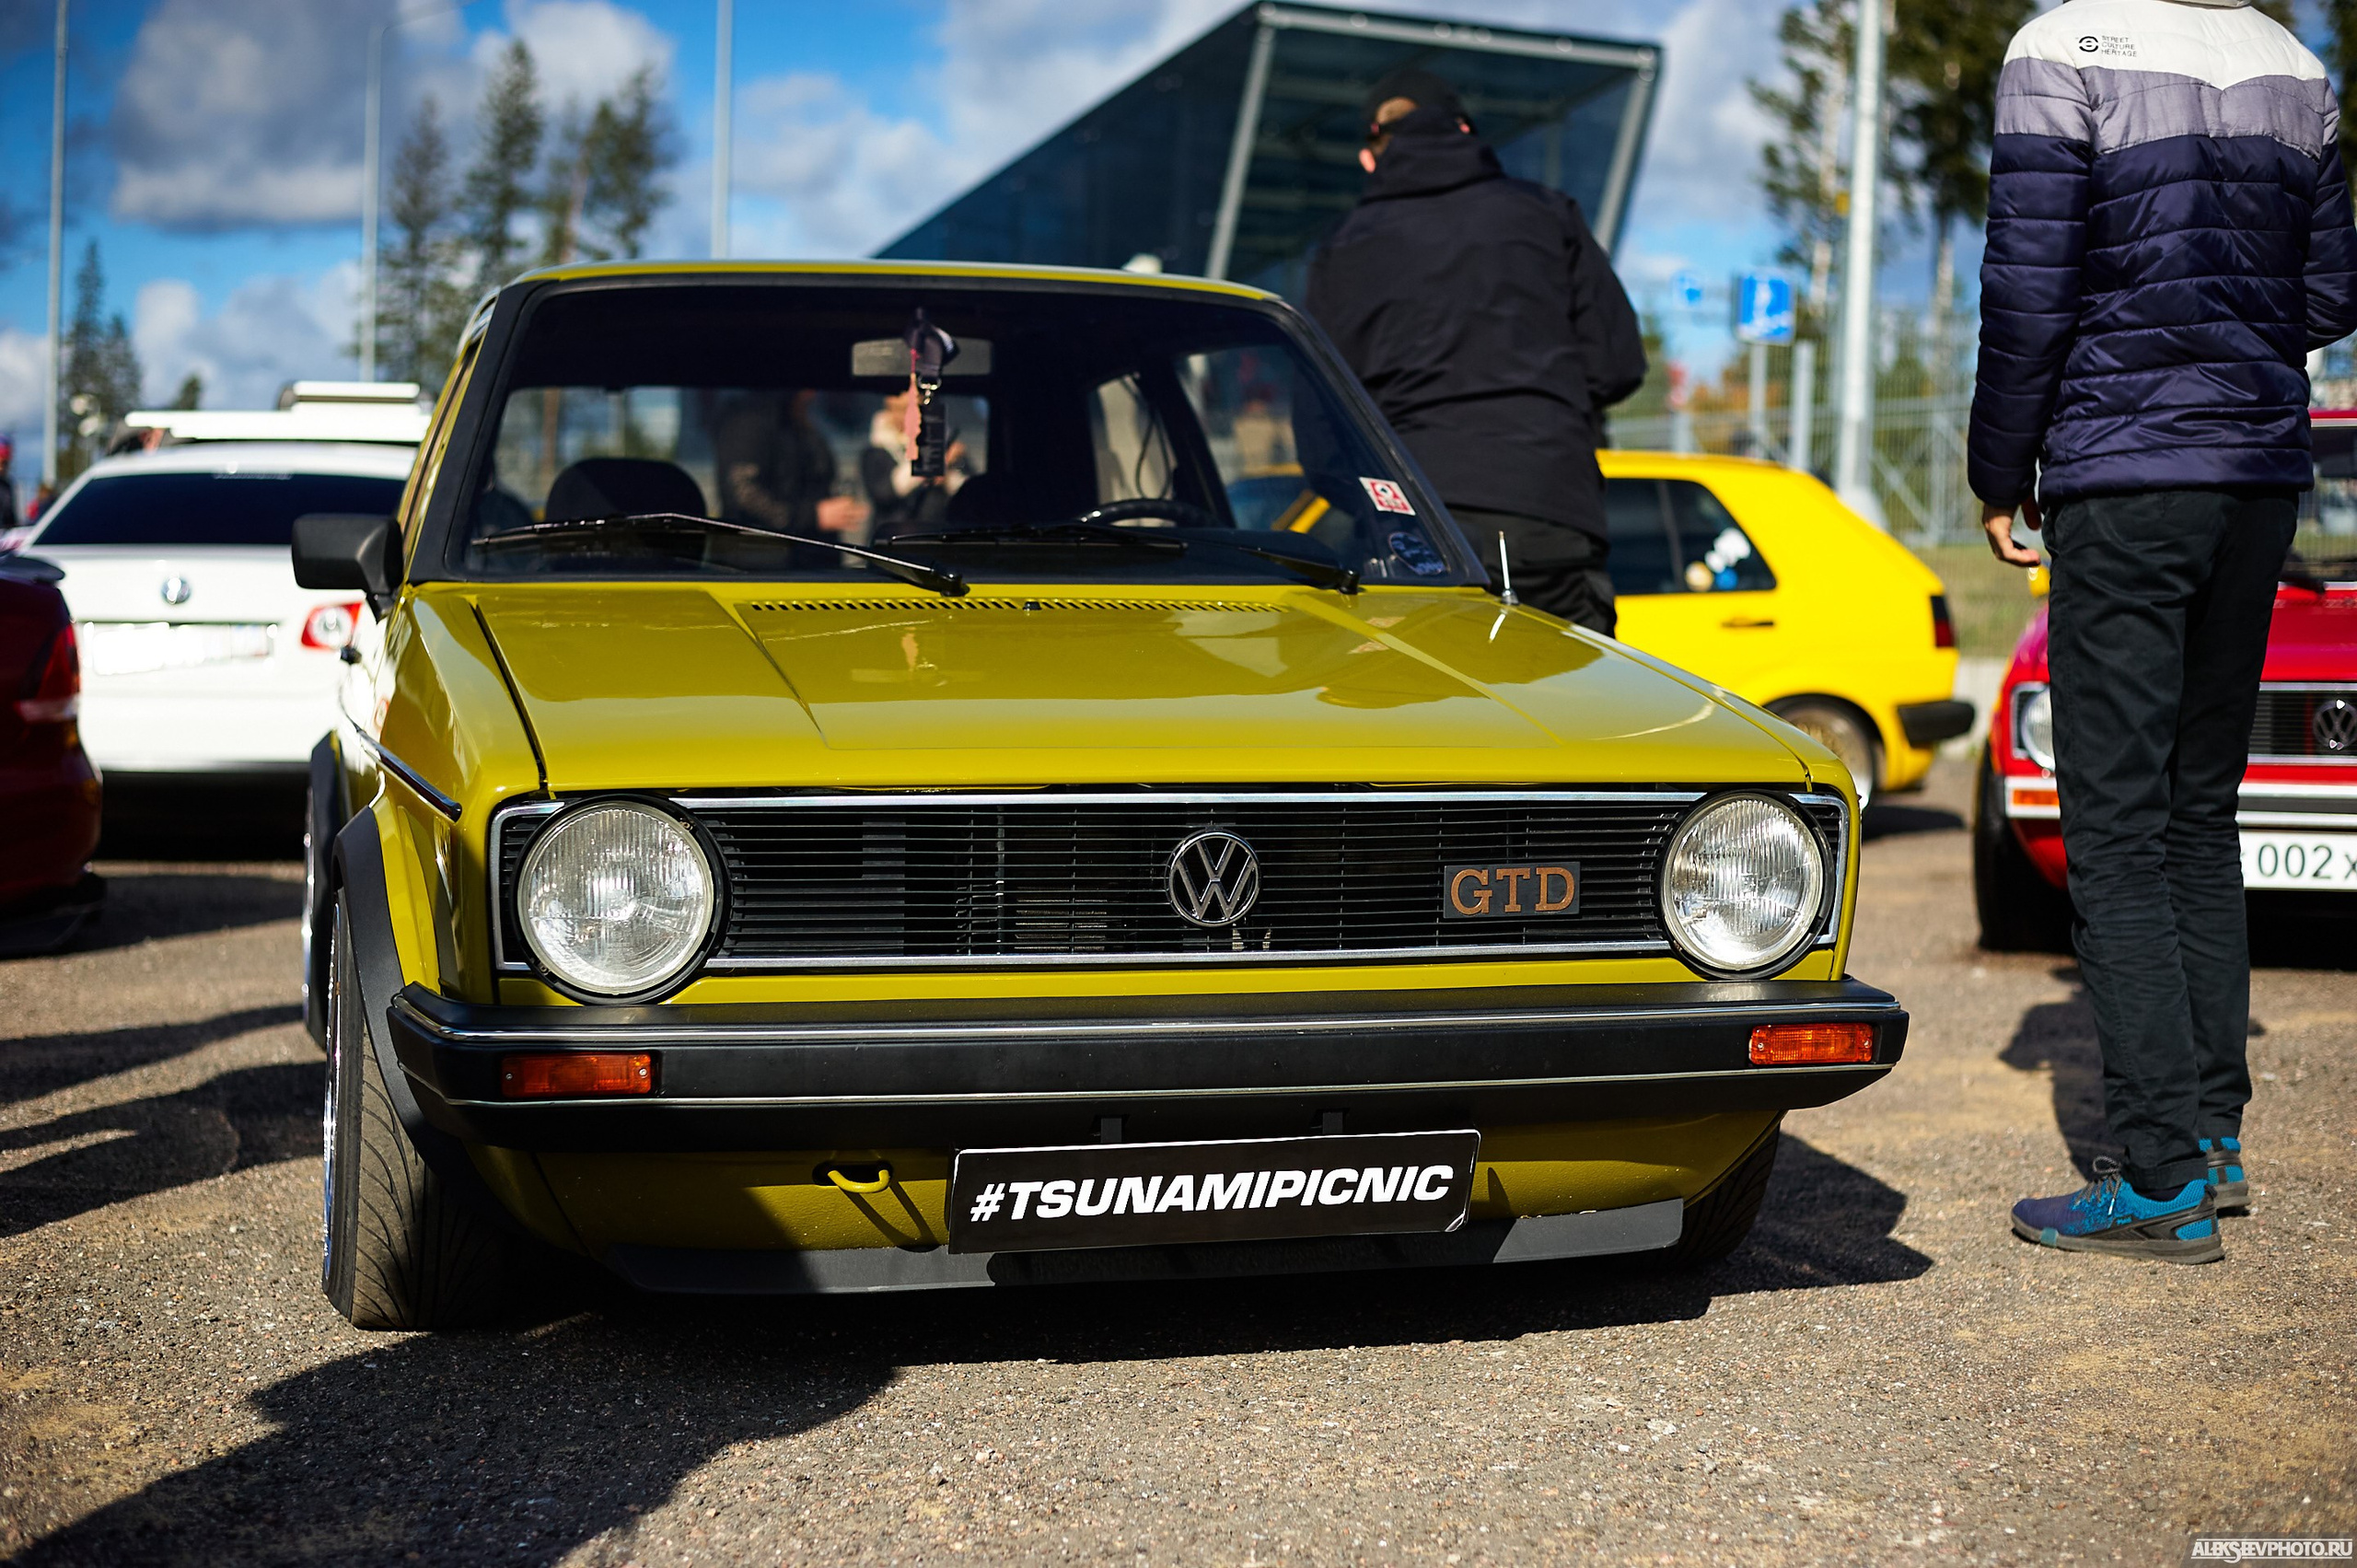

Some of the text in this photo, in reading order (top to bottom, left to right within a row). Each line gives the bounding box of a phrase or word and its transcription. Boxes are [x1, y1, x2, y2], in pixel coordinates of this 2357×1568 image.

[2101, 35, 2130, 43] STREET
[2101, 41, 2136, 50] CULTURE
[1167, 830, 1260, 926] VW
[1449, 865, 1576, 916] GTD
[970, 1164, 1455, 1223] #TSUNAMIPICNIC
